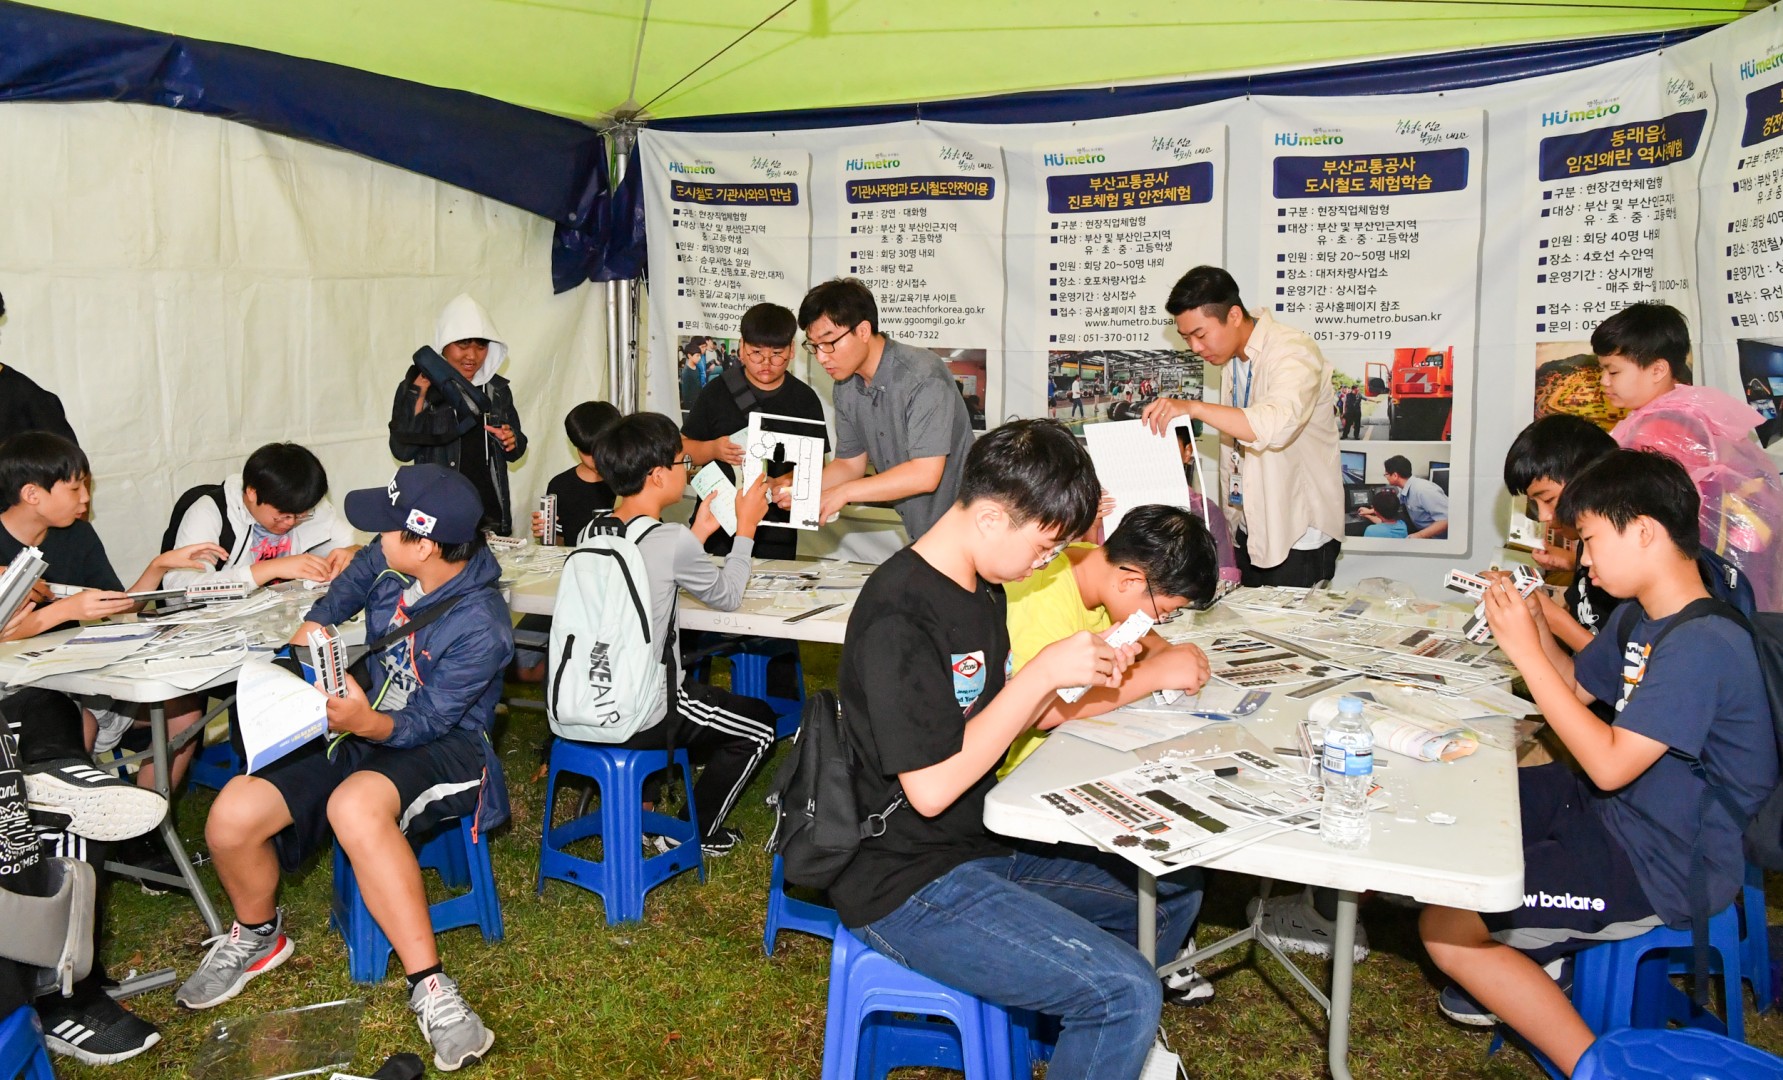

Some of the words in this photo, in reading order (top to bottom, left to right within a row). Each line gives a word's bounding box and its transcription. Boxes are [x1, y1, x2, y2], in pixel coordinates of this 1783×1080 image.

[1322, 156, 1416, 176] 부산교통공사
[1566, 148, 1633, 174] 임진왜란
[1090, 172, 1168, 191] 부산교통공사
[1305, 177, 1366, 193] 도시철도
[1370, 174, 1432, 192] 체험학습
[1554, 187, 1576, 198] 구분
[1587, 176, 1662, 194] 현장견학체험형
[676, 185, 714, 200] 도시철도
[716, 188, 768, 202] 기관사와의
[770, 188, 792, 202] 만남
[852, 182, 908, 198] 기관사직업과
[909, 181, 988, 196] 도시철도안전이용
[1068, 193, 1119, 210] 진로체험
[1122, 192, 1134, 206] 및
[1138, 186, 1191, 204] 안전체험
[1288, 207, 1308, 217] 구분
[1318, 204, 1390, 216] 현장직업체험형
[1553, 204, 1574, 216] 대상
[1584, 200, 1608, 212] 부산
[1612, 198, 1622, 210] 및
[860, 210, 874, 220] 구분
[880, 209, 896, 219] 강연
[904, 208, 926, 218] 대화형
[1584, 214, 1596, 226] 유
[1608, 213, 1618, 224] 초
[1631, 212, 1642, 224] 중
[680, 220, 696, 230] 대상
[716, 224, 723, 232] 및
[859, 226, 874, 234] 대상
[880, 223, 896, 233] 부산
[898, 223, 906, 232] 및
[908, 222, 957, 232] 부산인근지역
[1060, 220, 1078, 230] 구분
[1086, 216, 1146, 230] 현장직업체험형
[1288, 223, 1308, 234] 대상
[1317, 222, 1337, 233] 부산
[1340, 222, 1350, 232] 및
[1354, 220, 1417, 232] 부산인근지역
[712, 233, 742, 244] 고등학생
[881, 235, 888, 244] 초
[896, 234, 904, 244] 중
[911, 234, 942, 244] 고등학생
[1060, 235, 1076, 244] 대상
[1084, 234, 1102, 244] 부산
[1104, 233, 1113, 244] 및
[1116, 230, 1171, 242] 부산인근지역
[1317, 234, 1327, 246] 유
[1337, 234, 1346, 244] 초
[1357, 234, 1366, 245] 중
[1377, 232, 1419, 244] 고등학생
[1552, 235, 1572, 248] 인원
[1583, 232, 1607, 244] 회당
[1611, 230, 1638, 242] 40명
[1644, 228, 1660, 240] 내외
[734, 247, 750, 256] 내외
[859, 250, 874, 259] 인원
[881, 249, 896, 258] 회당
[899, 248, 916, 258] 30명
[918, 248, 935, 258] 내외
[1084, 246, 1094, 255] 유
[1102, 245, 1110, 254] 초
[1118, 244, 1126, 254] 중
[1136, 242, 1172, 253] 고등학생
[1288, 252, 1307, 263] 인원
[1316, 252, 1337, 262] 회당
[1340, 250, 1386, 261] 20~50명
[1390, 249, 1410, 260] 내외
[1550, 254, 1572, 266] 장소
[1583, 250, 1614, 262] 4호선
[1619, 248, 1654, 260] 수안역
[736, 258, 752, 268] 일원
[858, 264, 874, 274] 장소
[881, 264, 896, 274] 해당
[898, 264, 914, 273] 학교
[1059, 262, 1076, 271] 인원
[1084, 260, 1101, 271] 회당
[1104, 259, 1144, 270] 20~50명
[1148, 258, 1164, 268] 내외
[1287, 269, 1306, 280] 장소
[1316, 268, 1388, 279] 대저차량사업소
[1548, 270, 1596, 284] 운영기간
[1607, 266, 1654, 280] 상시개방
[1733, 264, 1765, 281] 운영기간
[714, 278, 742, 290] 상시접수
[896, 278, 926, 288] 상시접수
[1059, 276, 1076, 286] 장소
[1084, 275, 1146, 286] 호포차량사업소
[1286, 285, 1326, 296] 운영기간
[1336, 284, 1377, 296] 상시접수
[1606, 281, 1629, 293] 매주
[880, 294, 930, 304] 꿈길/교육기부
[932, 294, 957, 303] 사이트
[1059, 292, 1094, 302] 운영기간
[1102, 291, 1136, 301] 상시접수
[1735, 290, 1752, 304] 접수
[880, 304, 985, 316] www.teachforkorea.go.kr
[1060, 307, 1076, 317] 접수
[1085, 306, 1136, 317] 공사홈페이지
[1139, 305, 1156, 315] 참조
[1286, 302, 1306, 312] 접수
[1315, 301, 1376, 312] 공사홈페이지
[1380, 300, 1400, 312] 참조
[1548, 303, 1571, 314] 접수
[1582, 302, 1606, 314] 유선
[880, 316, 966, 326] www.ggoomgil.go.kr
[1315, 312, 1442, 324] www.humetro.busan.kr
[1740, 314, 1758, 328] 문의
[685, 321, 699, 330] 문의
[1548, 321, 1570, 332] 문의
[882, 330, 939, 340] 51-640-7322
[1059, 334, 1076, 343] 문의
[1084, 332, 1149, 342] 051-370-0112
[1314, 330, 1392, 340] 051-379-0119
[590, 640, 612, 682] NIKE
[590, 684, 620, 727] AIR
